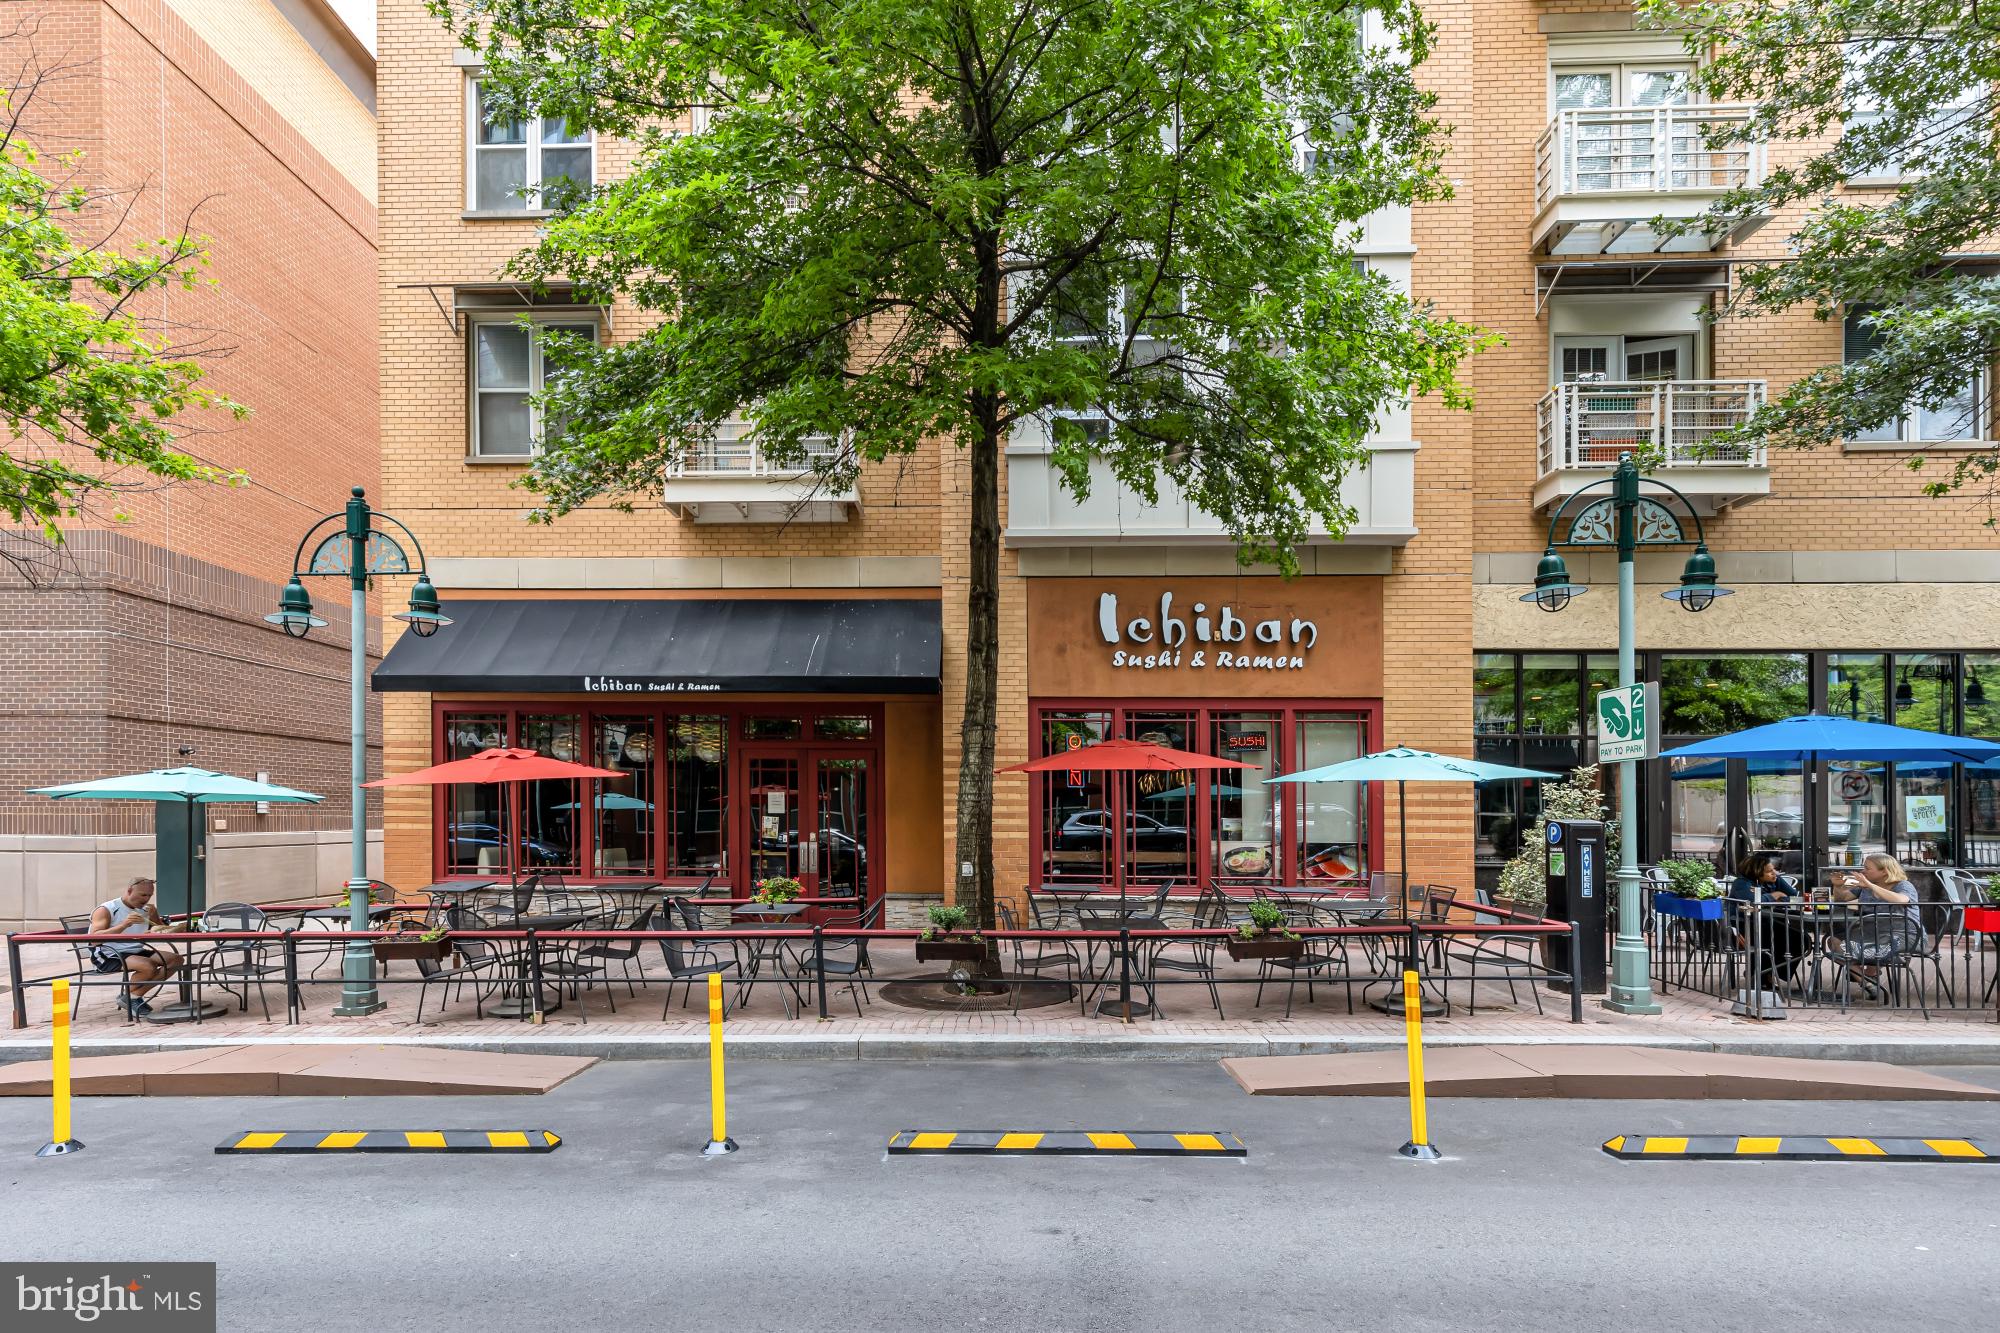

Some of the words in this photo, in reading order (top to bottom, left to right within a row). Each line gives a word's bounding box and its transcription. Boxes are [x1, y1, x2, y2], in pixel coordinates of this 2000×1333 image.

[1099, 591, 1318, 649] Ichiban
[1112, 650, 1181, 669] Sushi
[1190, 650, 1206, 668] &
[1216, 651, 1304, 669] Ramen
[584, 676, 642, 692] Ichiban
[648, 682, 675, 692] Sushi
[687, 682, 721, 691] Ramen
[1632, 688, 1644, 709] 2
[1229, 736, 1265, 747] SUSHI
[1600, 748, 1613, 757] PAY
[1614, 746, 1624, 755] TO
[1625, 744, 1644, 754] PARK
[1550, 826, 1558, 841] P
[1583, 846, 1591, 867] PAY
[1583, 869, 1591, 896] HERE
